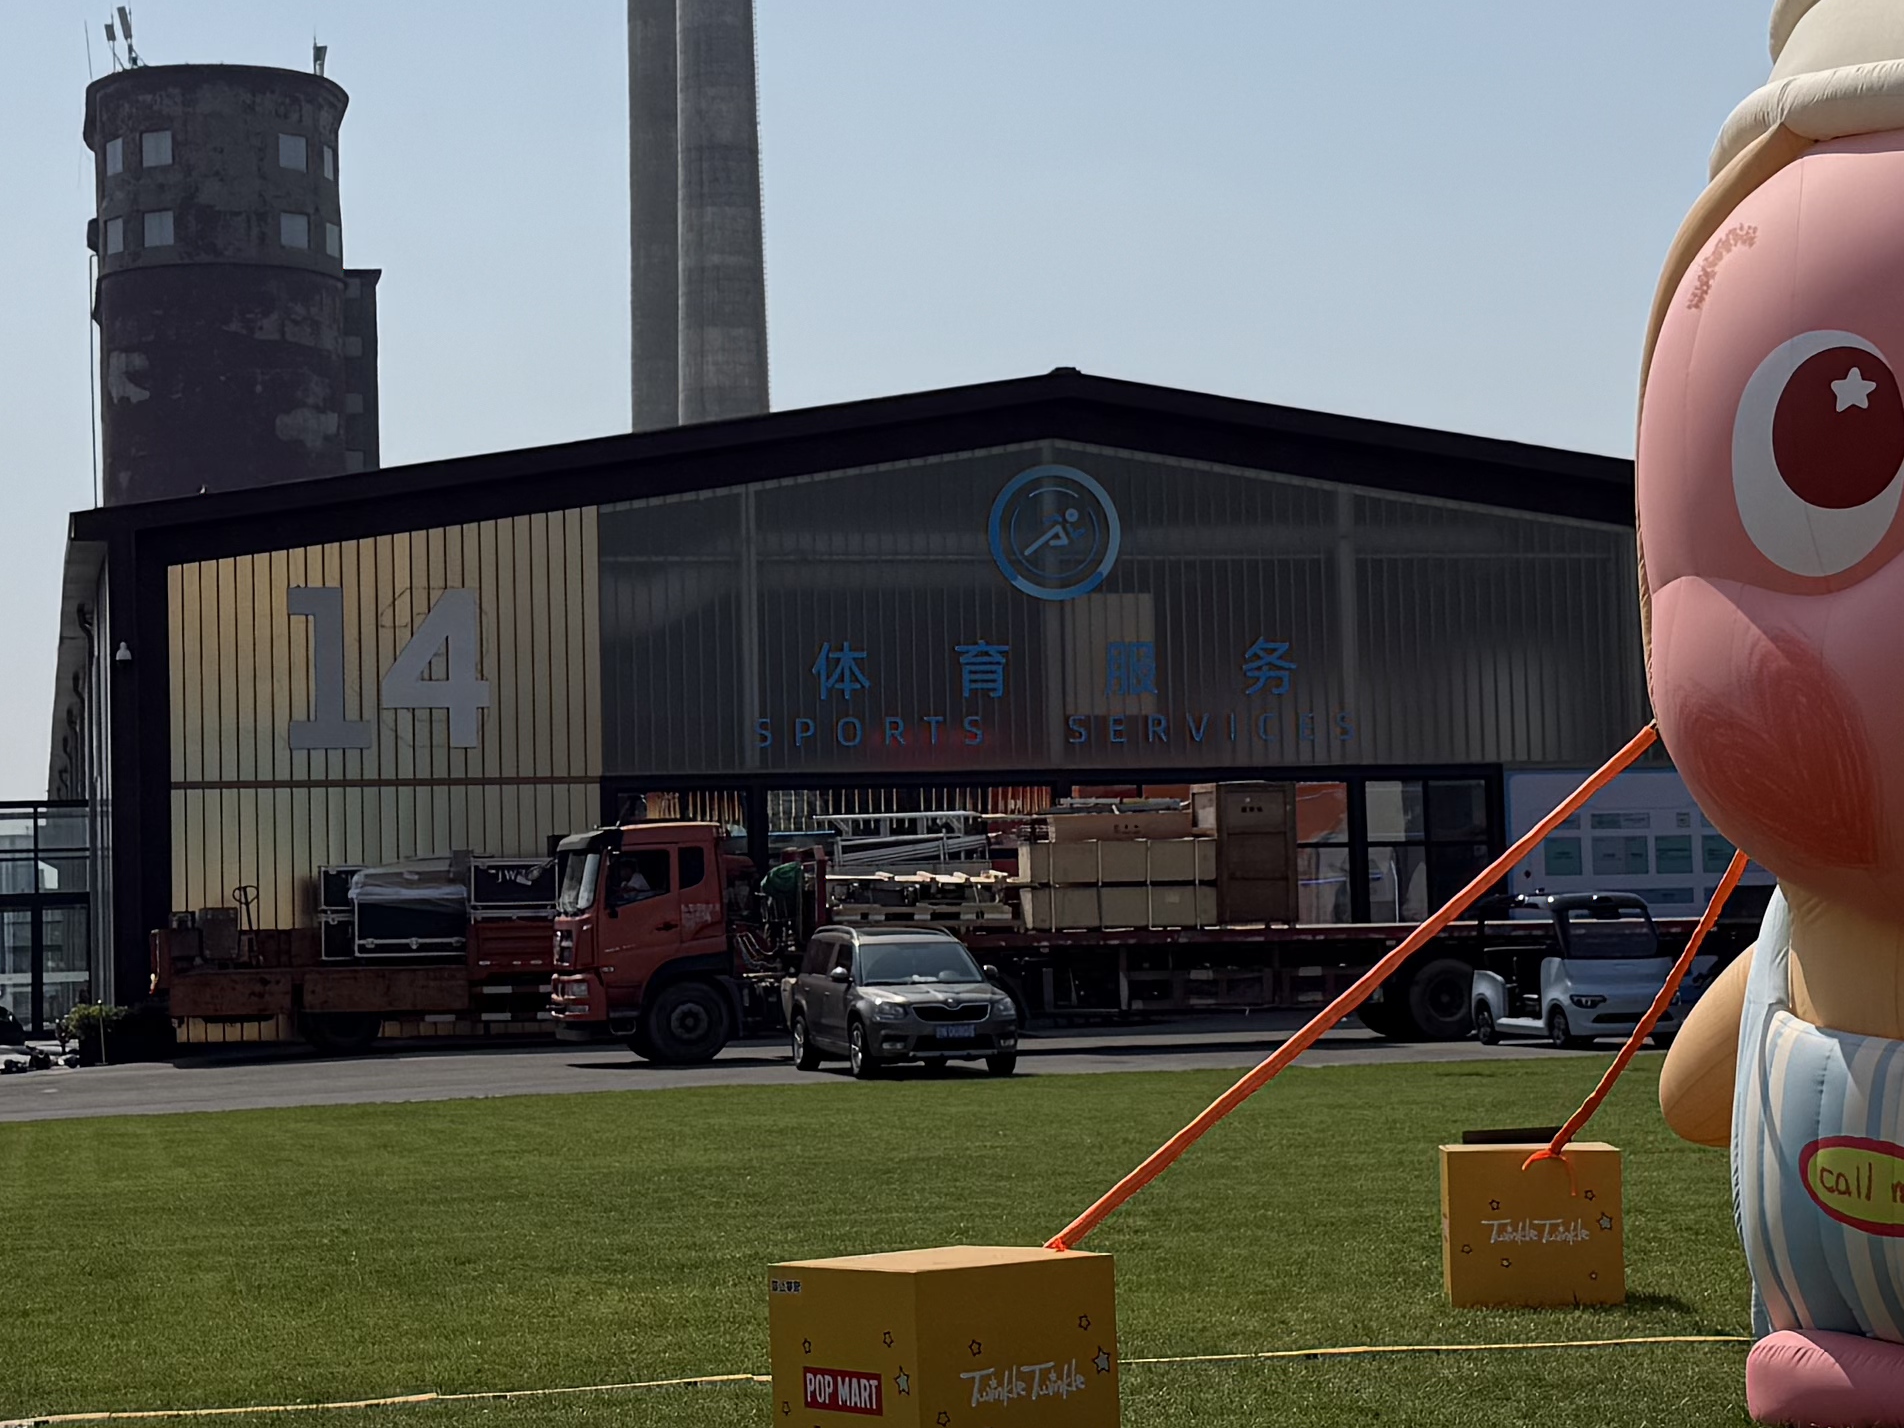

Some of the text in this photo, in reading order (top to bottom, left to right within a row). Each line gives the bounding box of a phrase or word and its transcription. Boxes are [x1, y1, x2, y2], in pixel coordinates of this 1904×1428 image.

[287, 586, 490, 750] 14
[812, 636, 1297, 700] 体育服务
[756, 711, 1356, 748] SPORTS SERVICES
[1819, 1162, 1873, 1202] call
[806, 1373, 879, 1409] POP MART
[961, 1359, 1085, 1408] Twinkle Twinkle
